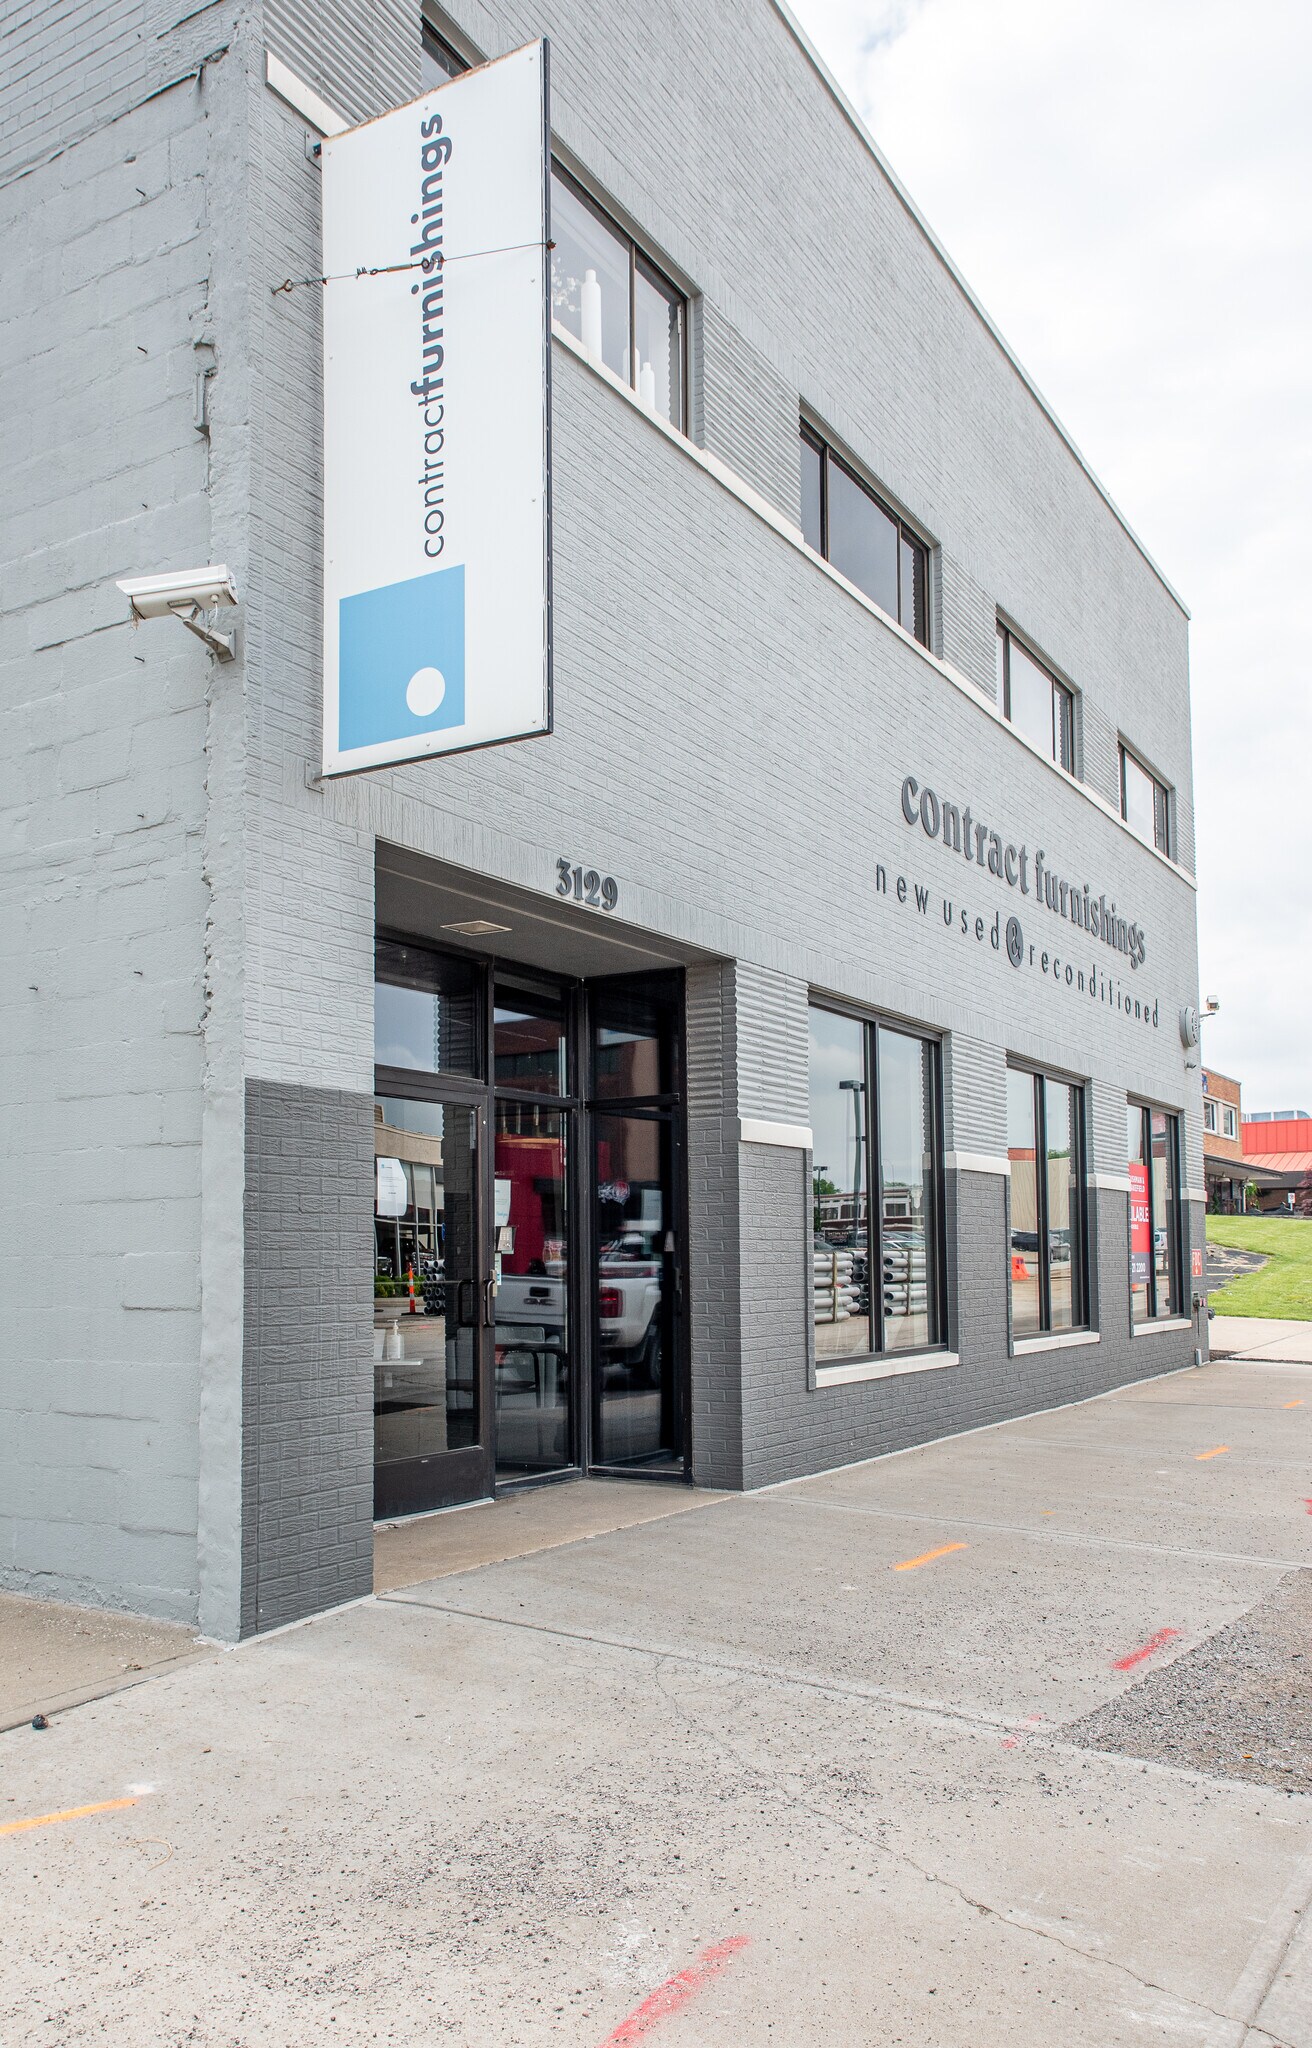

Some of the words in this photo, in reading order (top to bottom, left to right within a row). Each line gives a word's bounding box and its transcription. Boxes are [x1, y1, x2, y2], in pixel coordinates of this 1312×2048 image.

[556, 857, 618, 910] 3129
[876, 864, 929, 914] new
[943, 900, 999, 951] used
[1009, 920, 1022, 963] &
[1029, 944, 1159, 1028] reconditioned
[901, 776, 1029, 894] contract
[1035, 850, 1146, 969] furnishings
